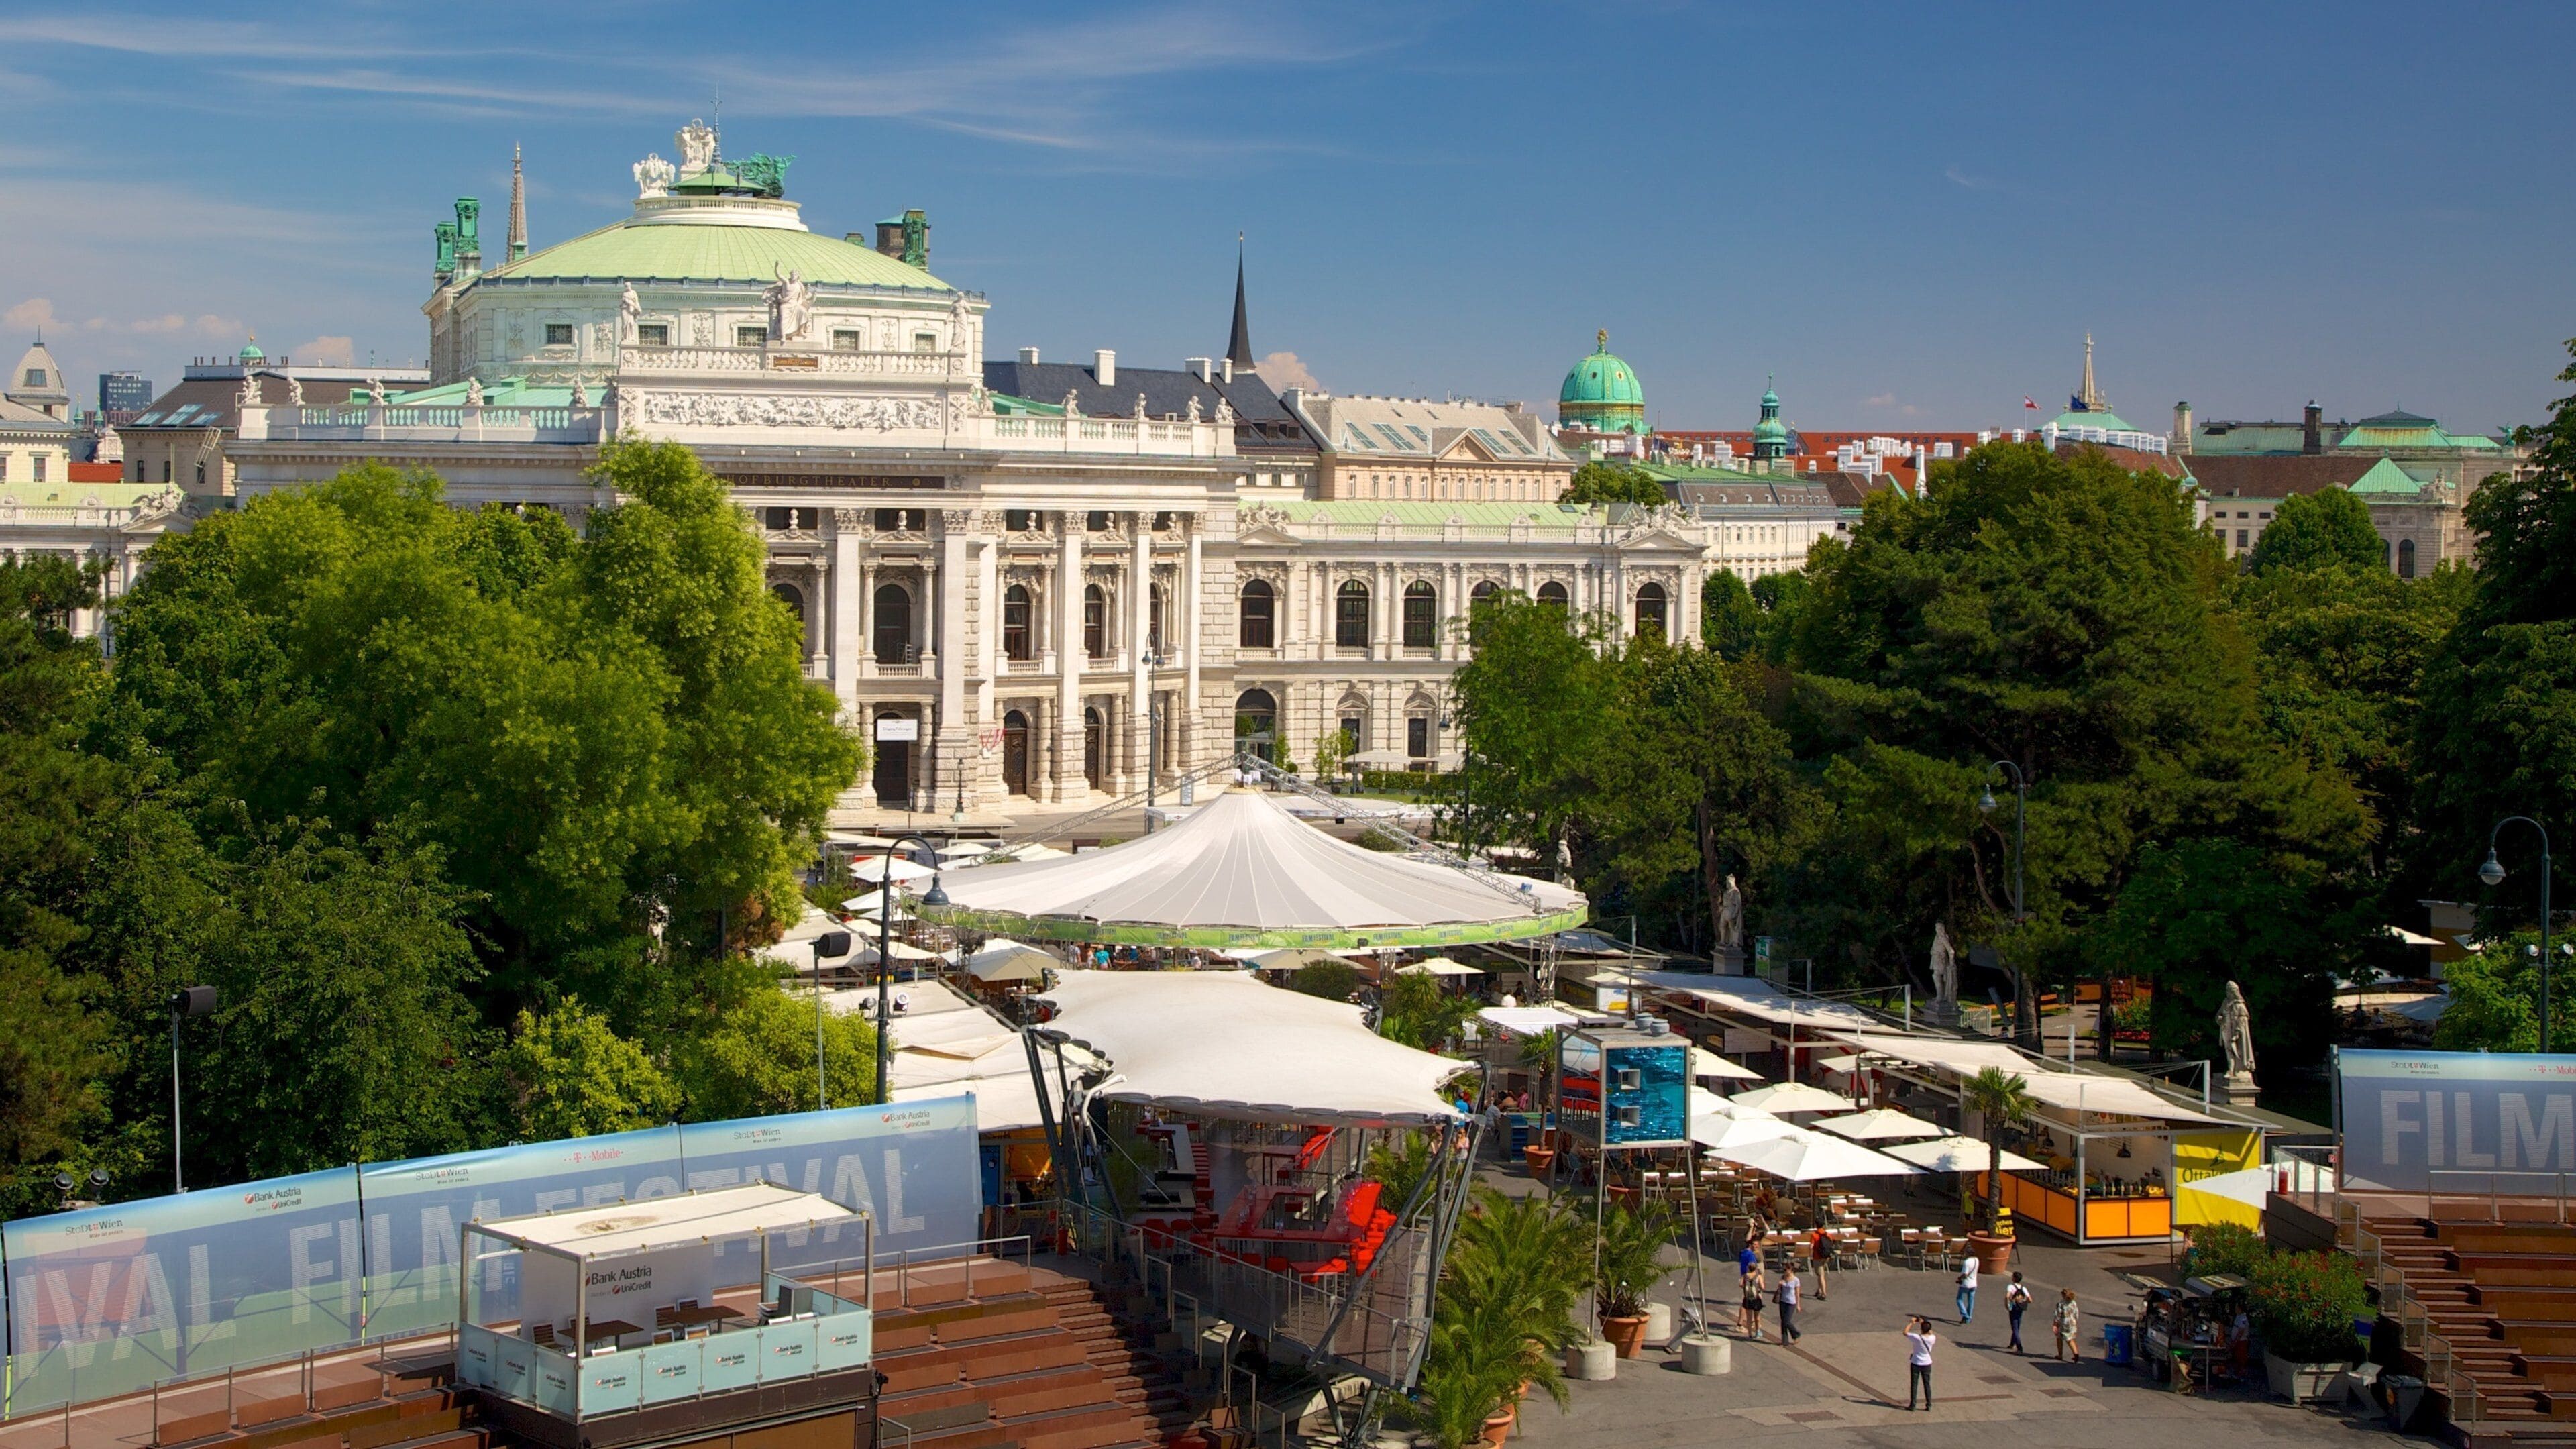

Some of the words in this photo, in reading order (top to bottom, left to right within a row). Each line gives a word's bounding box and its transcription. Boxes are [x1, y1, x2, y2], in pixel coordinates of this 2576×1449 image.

[890, 1113, 907, 1121] Bank
[908, 1110, 930, 1119] Austria
[2381, 1090, 2575, 1169] FILM
[254, 1192, 274, 1202] Bank
[276, 1187, 301, 1199] Austria
[278, 1199, 302, 1208] UniCredit
[98, 1220, 123, 1230] Wien
[290, 1199, 502, 1325] FILM
[591, 1270, 616, 1285] Bank
[619, 1265, 652, 1281] Austria
[621, 1281, 652, 1293] UniCredit
[0, 1244, 237, 1381] IVAL
